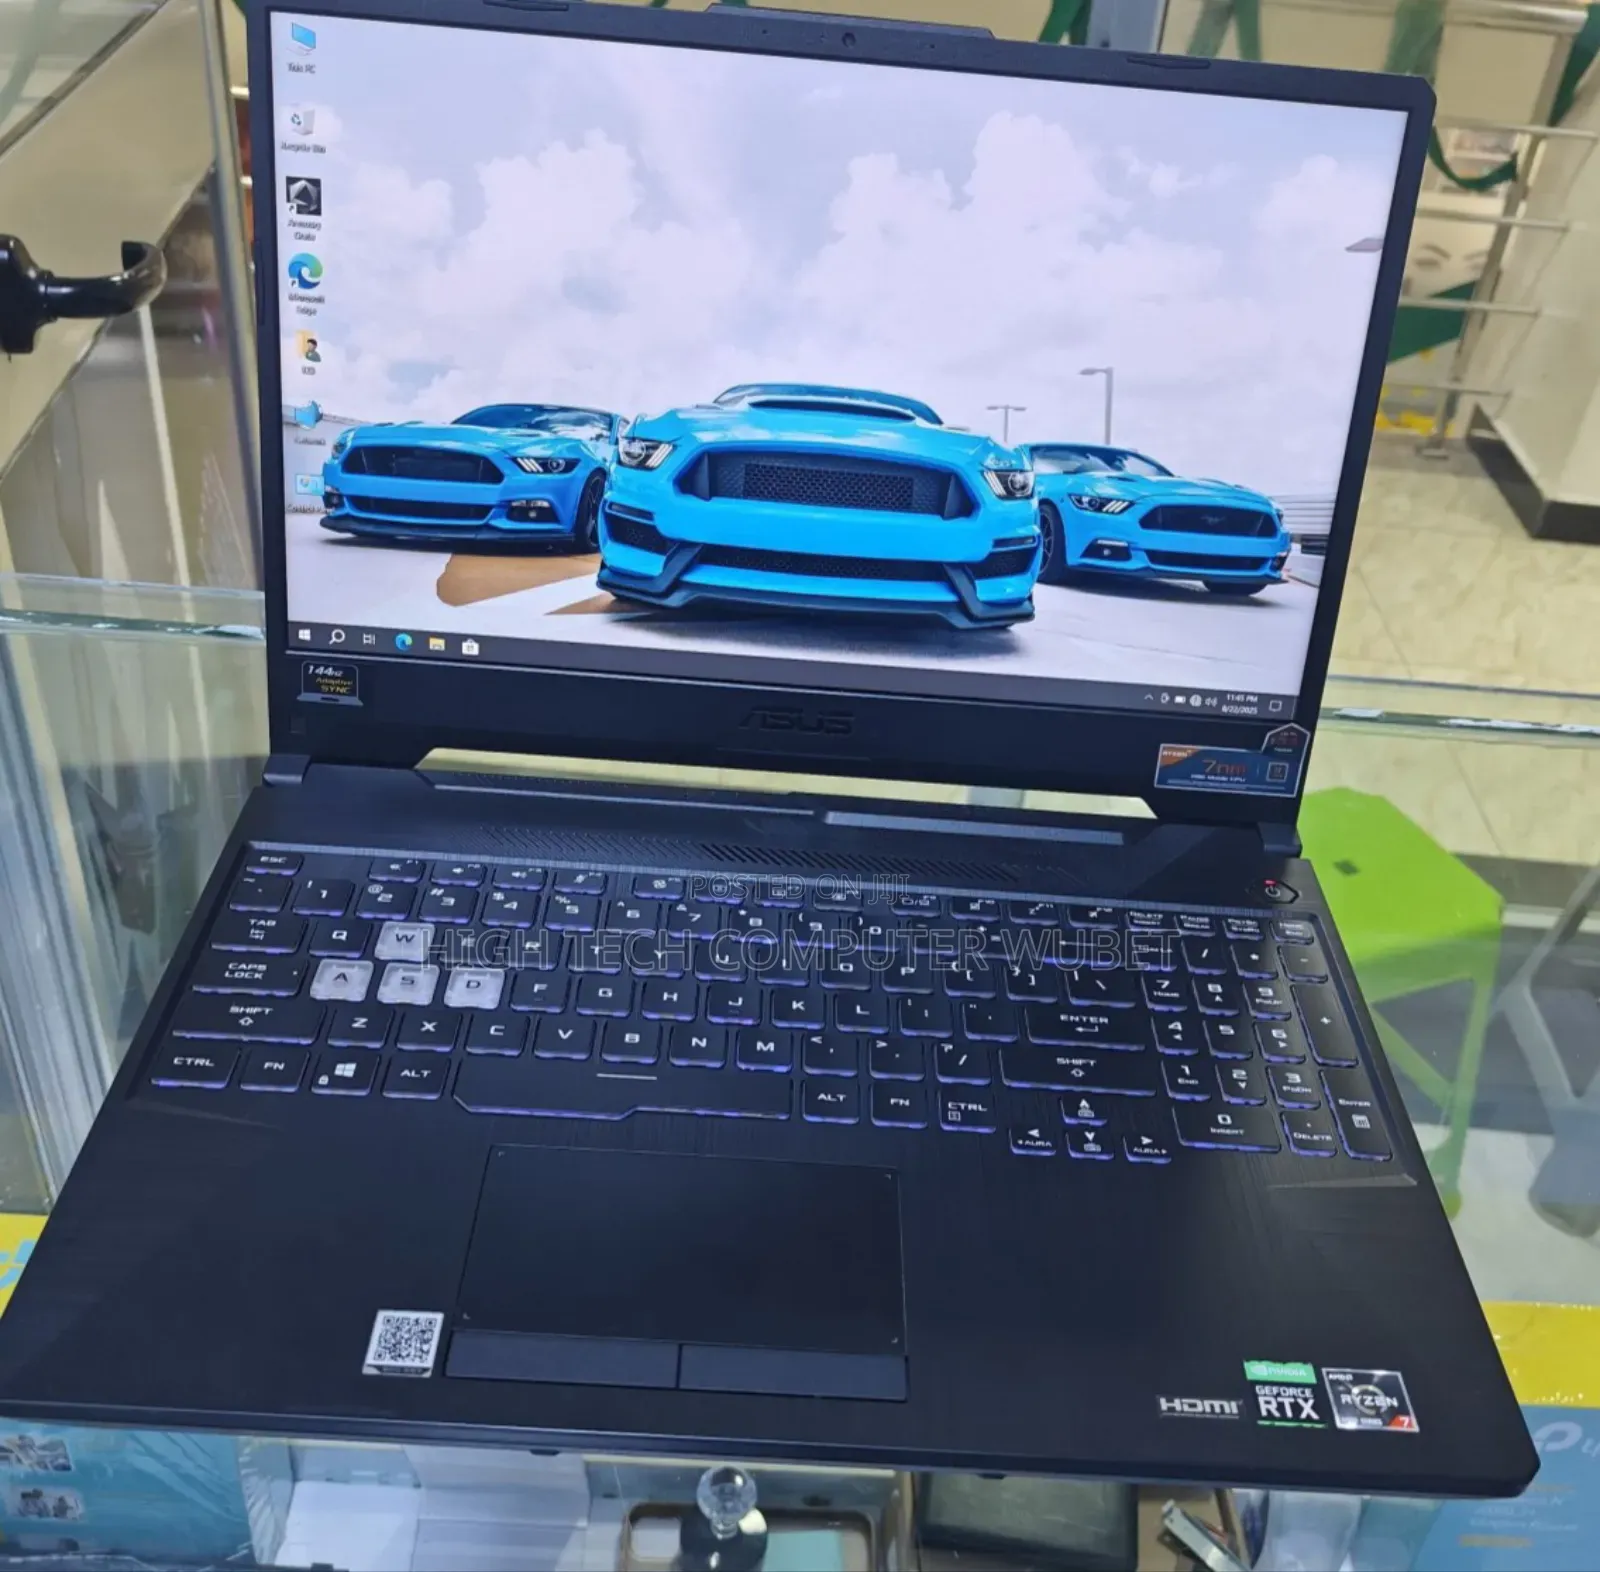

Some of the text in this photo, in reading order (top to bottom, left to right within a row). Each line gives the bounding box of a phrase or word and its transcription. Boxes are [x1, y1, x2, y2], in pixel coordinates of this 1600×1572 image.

[738, 706, 856, 735] ASUS
[260, 856, 287, 864] ESC
[377, 893, 393, 903] 2
[441, 897, 456, 907] 3
[503, 901, 518, 911] 4
[249, 919, 276, 927] TAB
[332, 930, 348, 941] Q
[395, 934, 416, 943] W
[228, 962, 268, 971] CAPS
[224, 971, 264, 980] LOCK
[332, 972, 349, 983] A
[400, 976, 416, 985] S
[466, 980, 481, 989] D
[533, 984, 548, 993] F
[1156, 980, 1171, 989] 7
[598, 988, 613, 997] G
[664, 992, 679, 1002] H
[728, 997, 744, 1006] J
[791, 1000, 806, 1011] K
[229, 1006, 274, 1014] SHIFT
[856, 1005, 870, 1014] L
[352, 1017, 368, 1028] Z
[1059, 1014, 1109, 1024] ENTER
[421, 1021, 438, 1032] X
[489, 1025, 505, 1035] C
[1168, 1021, 1183, 1031] 4
[557, 1029, 574, 1040] V
[624, 1033, 640, 1044] B
[692, 1037, 707, 1048] N
[756, 1041, 775, 1052] M
[173, 1057, 216, 1067] CTRL
[263, 1061, 285, 1071] FN
[1056, 1057, 1097, 1067] SHIFT
[400, 1069, 431, 1078] ALT
[1285, 1072, 1301, 1083] 3
[817, 1093, 847, 1102] ALT
[890, 1098, 910, 1107] FN
[948, 1102, 988, 1112] CTRL
[1255, 1385, 1314, 1398] GEFORCE
[1159, 1397, 1239, 1414] HDMI
[1340, 1393, 1399, 1408] RYZEN
[1258, 1397, 1321, 1420] RTX
[1399, 1415, 1410, 1427] 7
